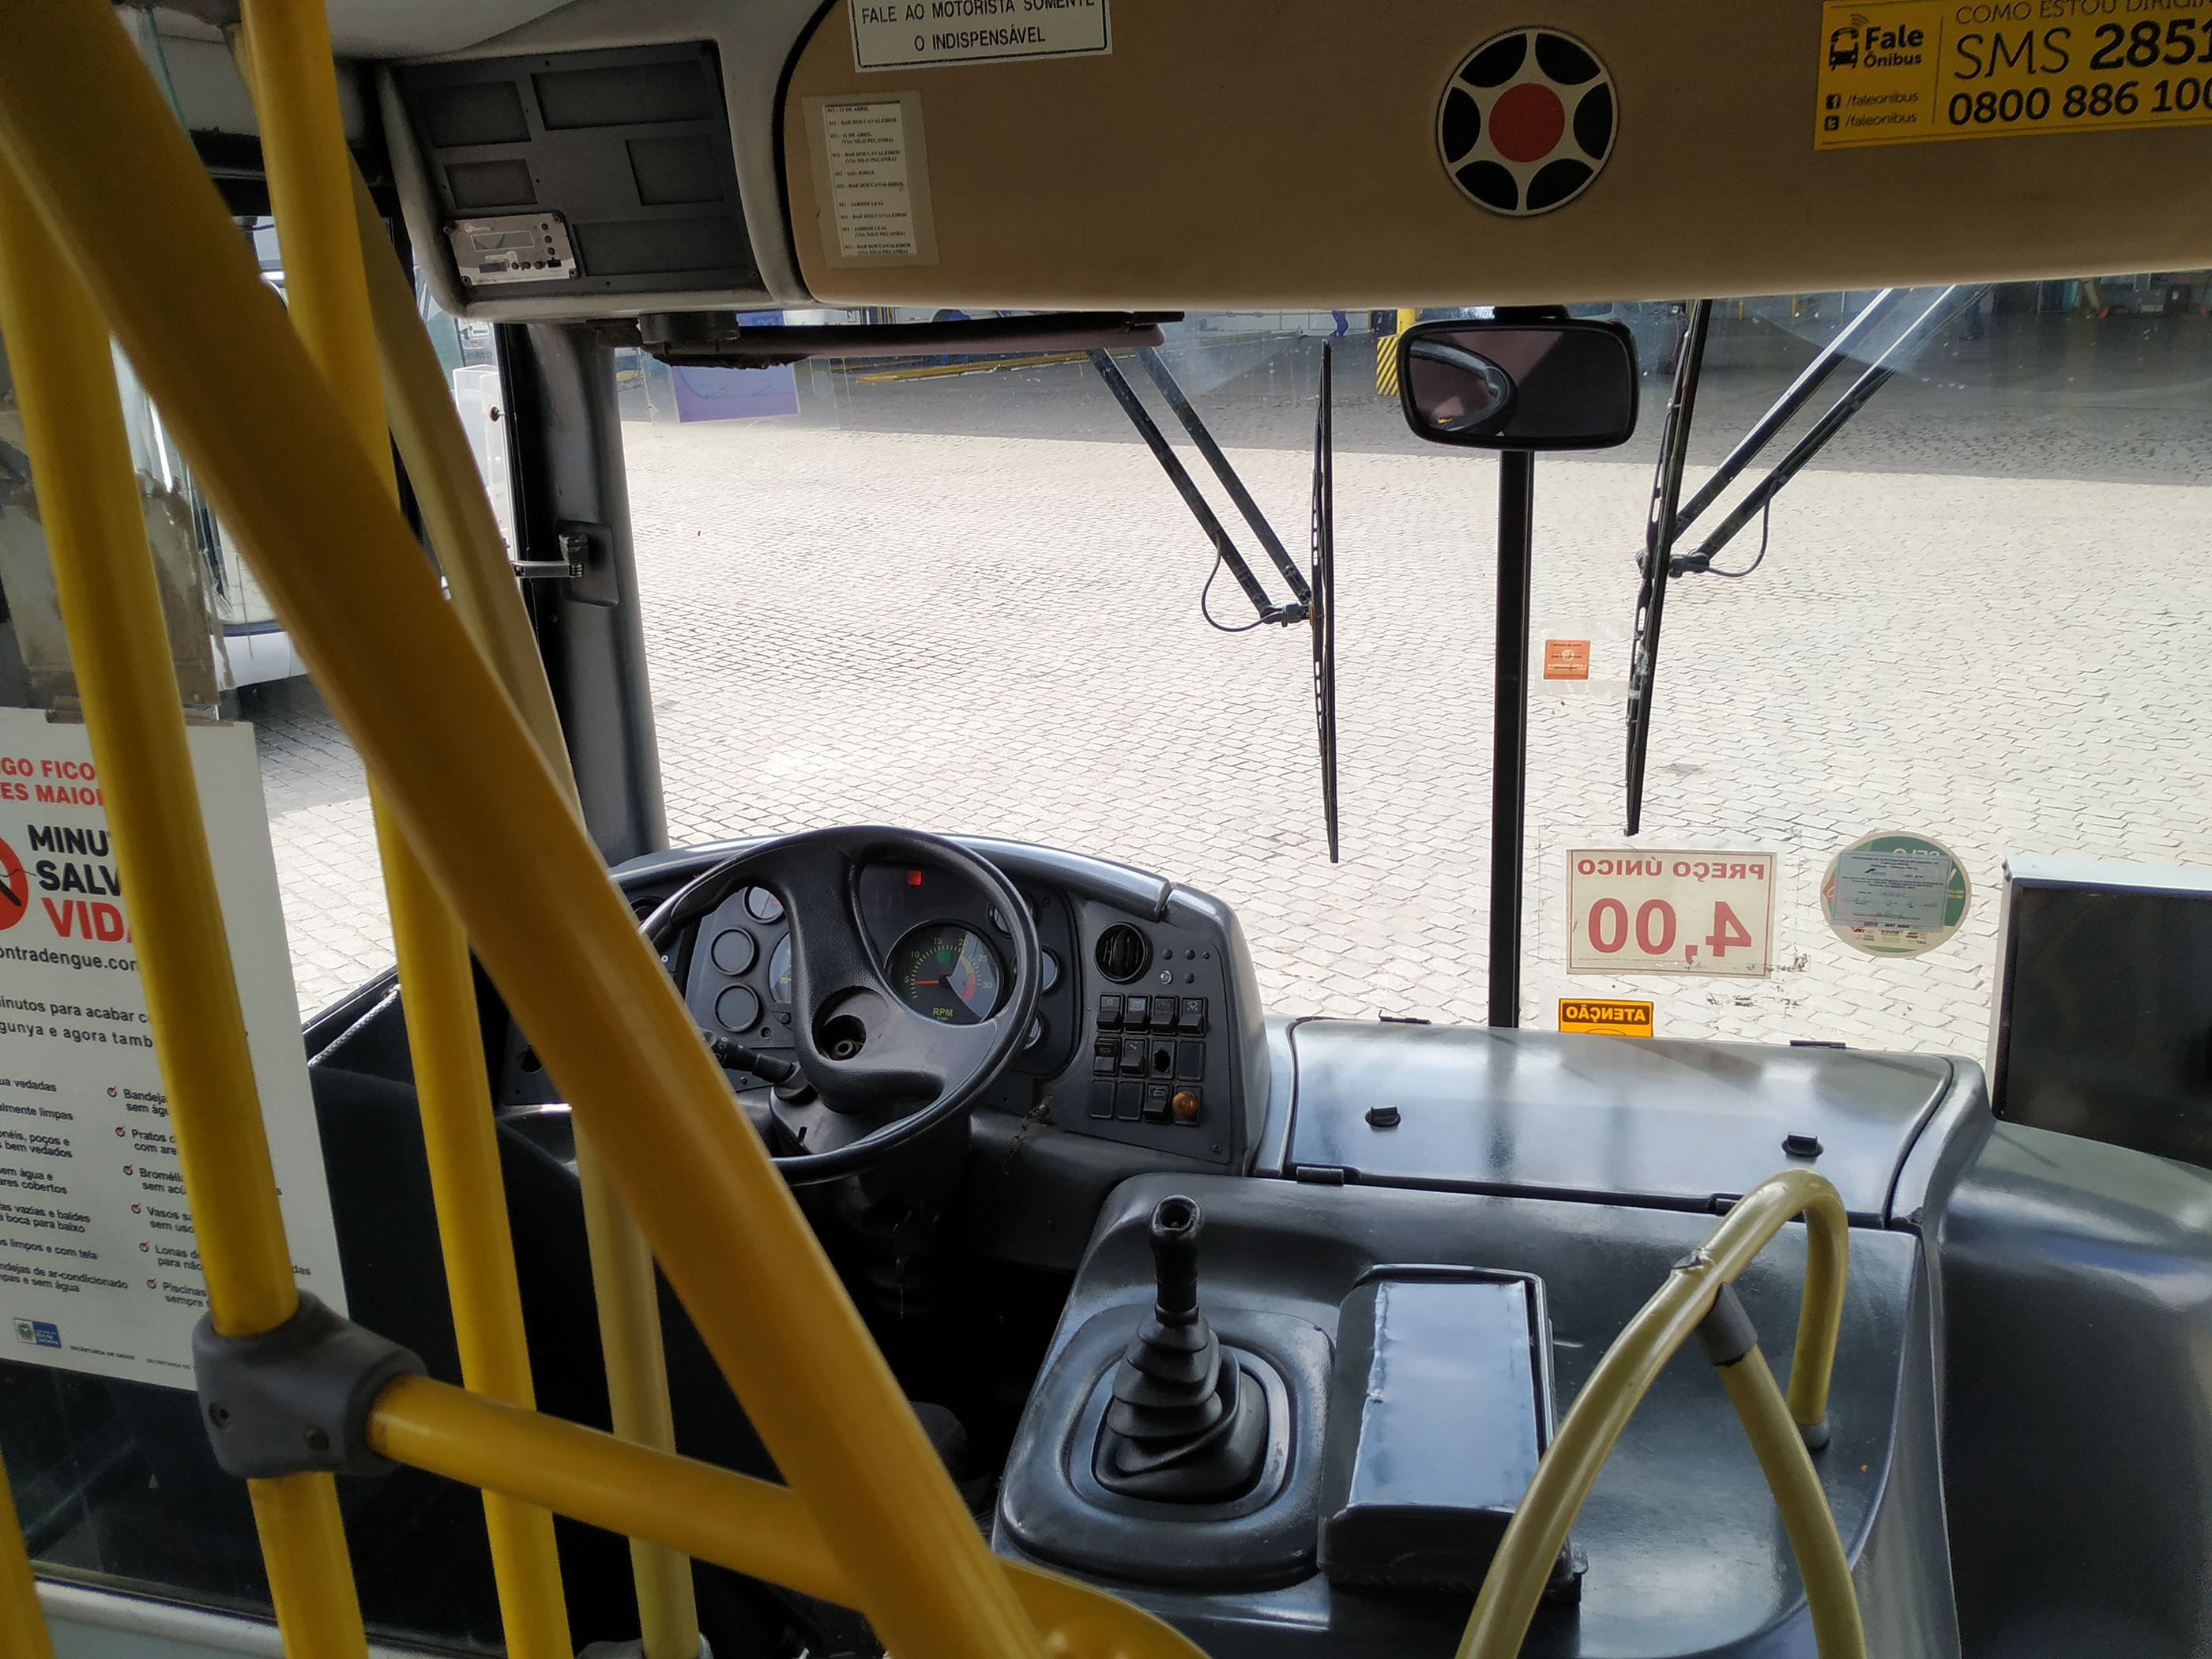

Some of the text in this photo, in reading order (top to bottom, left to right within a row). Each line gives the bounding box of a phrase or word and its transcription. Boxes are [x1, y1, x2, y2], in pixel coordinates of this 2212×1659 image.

[862, 6, 897, 24] FALE
[905, 3, 925, 21] AO
[933, 0, 1015, 19] MOTORISTA
[1956, 2, 2032, 24] COMO
[915, 24, 1046, 51] O INDISPENSÁVEL
[1865, 24, 1924, 51] Fale
[1864, 51, 1922, 69] Ônibus
[1954, 27, 2071, 80] SMS
[1949, 87, 2050, 125] 0800
[2063, 81, 2139, 118] 886
[27, 824, 111, 857] MINU
[41, 897, 133, 943] VID
[982, 980, 993, 989] 30
[0, 996, 46, 1012] inutos
[50, 1003, 81, 1017] para
[85, 1007, 134, 1022] acabar
[932, 1007, 953, 1017] RPM
[49, 1028, 58, 1036] e
[63, 1028, 106, 1043] agora
[111, 1032, 153, 1048] tamb
[13, 1079, 57, 1093] vedadas
[39, 1107, 73, 1121] limpas
[126, 1103, 149, 1113] sem
[29, 1134, 61, 1147] poços
[131, 1129, 167, 1143] Pratos
[5, 1140, 27, 1152] bem
[29, 1144, 73, 1158] vedados
[134, 1142, 157, 1153] com
[20, 1168, 44, 1180] água
[21, 1181, 68, 1194] cobertos
[142, 1182, 165, 1192] sem
[14, 1206, 46, 1217] vazias
[57, 1209, 91, 1223] baldes
[147, 1206, 179, 1220] Vasos
[6, 1213, 85, 1233] boca para baixo
[150, 1220, 172, 1230] sem
[9, 1238, 43, 1251] limpos
[55, 1247, 77, 1257] com
[78, 1249, 98, 1260] tela
[155, 1245, 188, 1258] Lonas
[157, 1257, 181, 1267] para
[32, 1277, 53, 1288] sem
[55, 1281, 80, 1292] água
[33, 1266, 46, 1277] de
[48, 1270, 128, 1289] ar-condicionado
[163, 1281, 207, 1297] Piscinas
[165, 1294, 204, 1307] sempre
